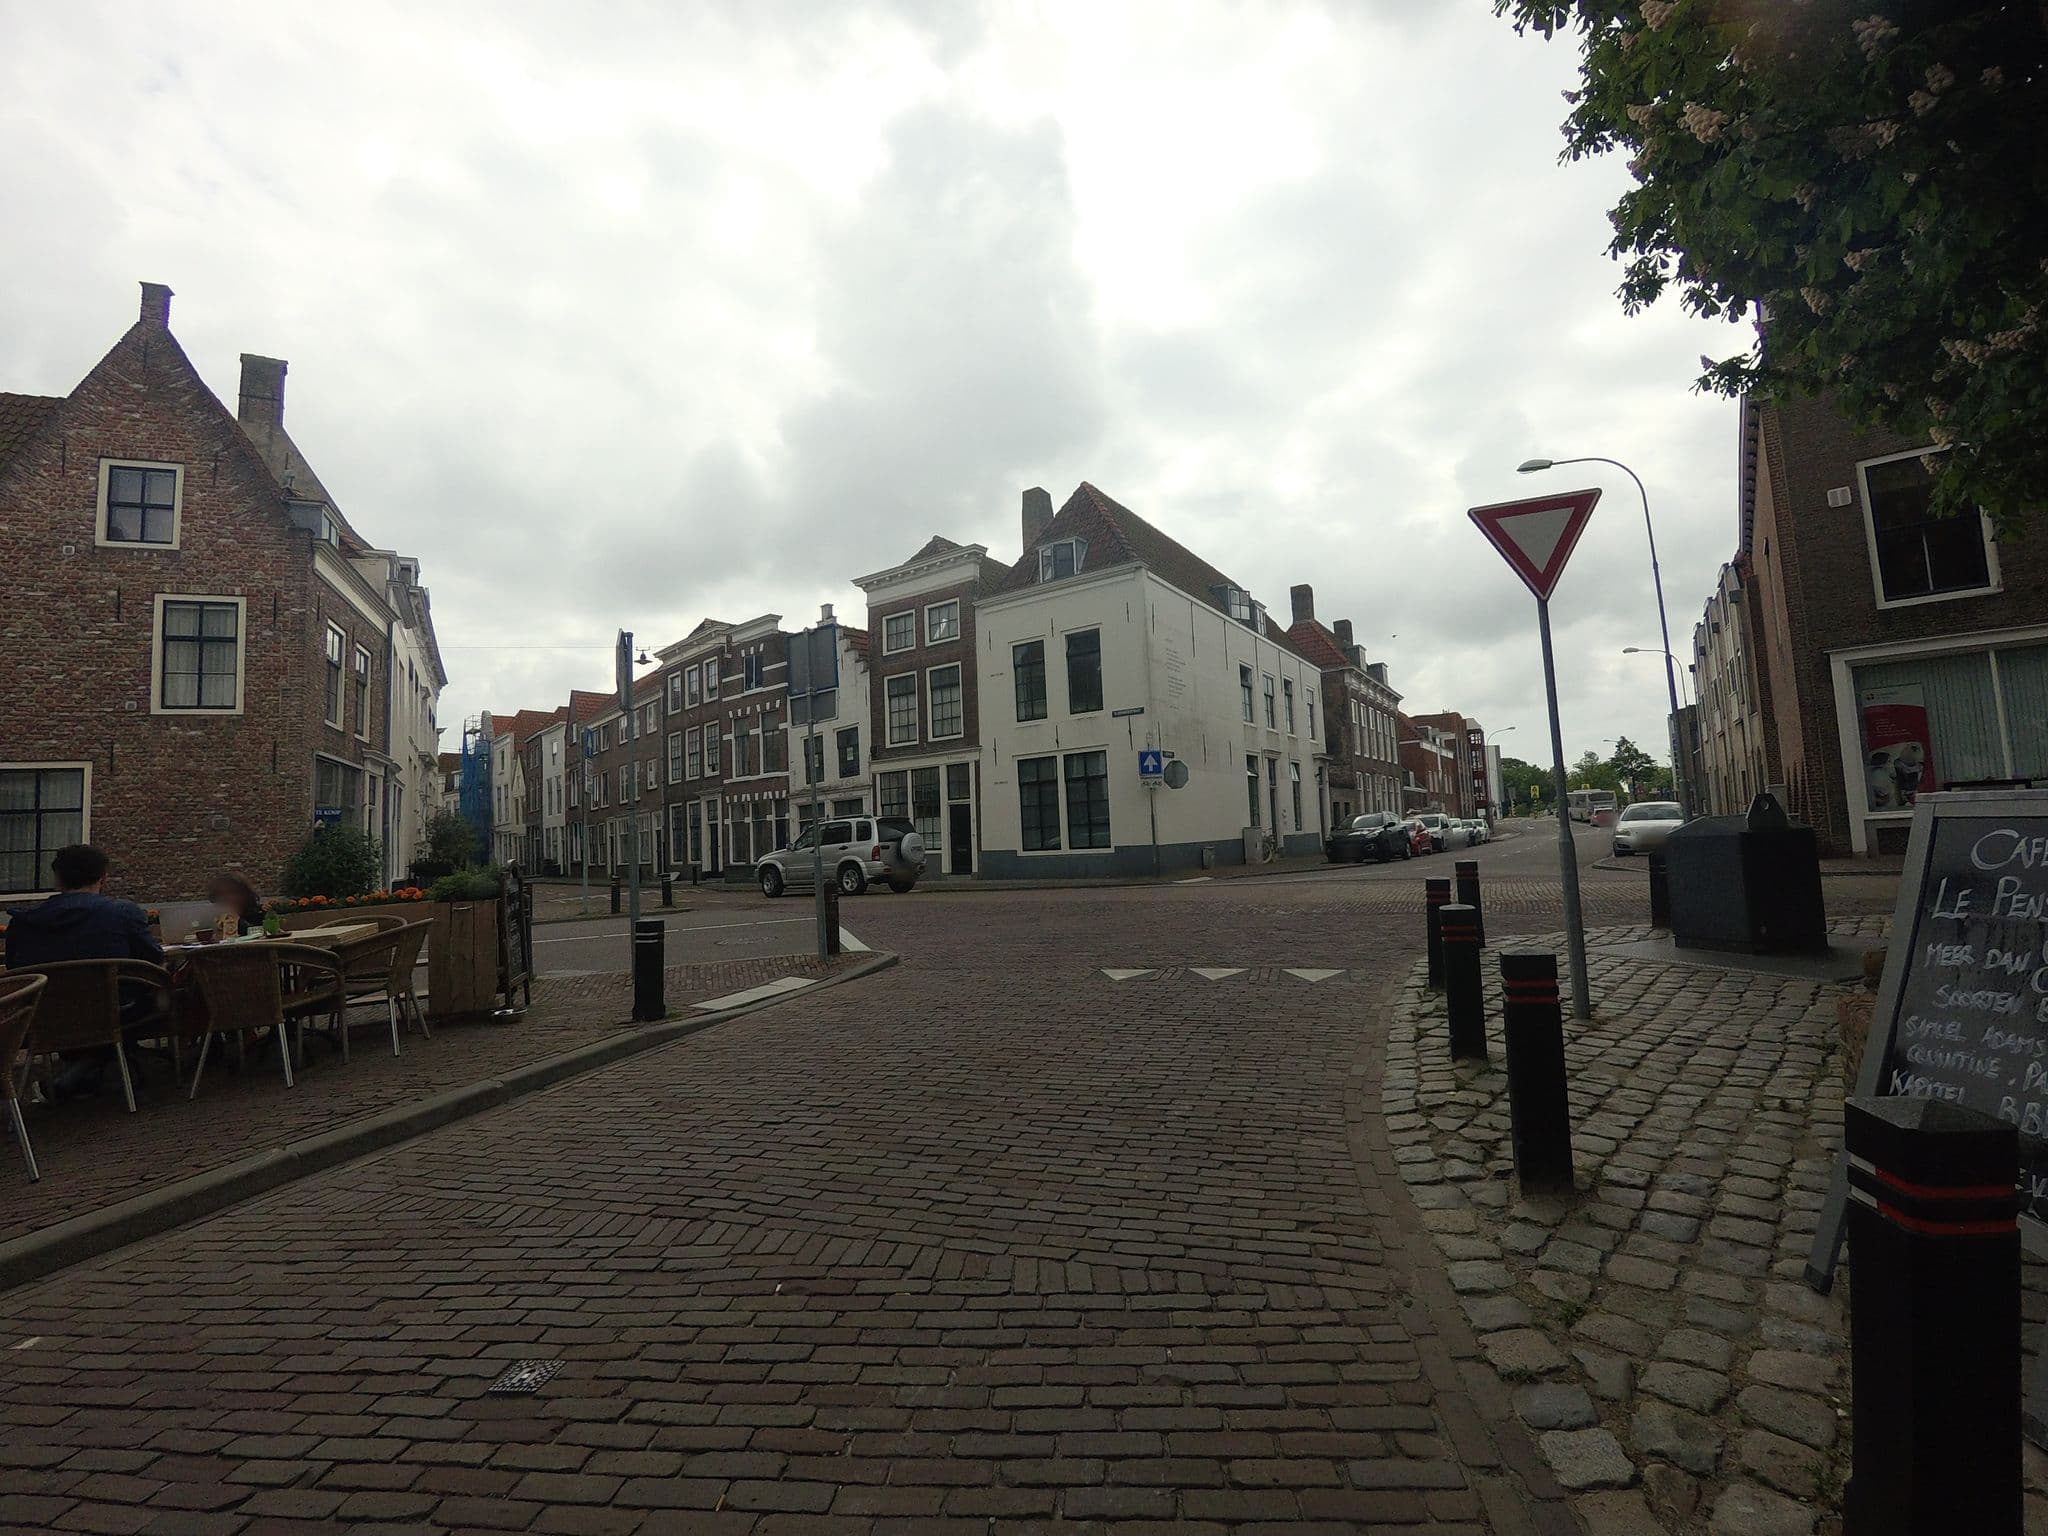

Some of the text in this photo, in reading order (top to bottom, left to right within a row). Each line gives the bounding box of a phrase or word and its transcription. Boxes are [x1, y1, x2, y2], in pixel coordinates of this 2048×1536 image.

[1931, 876, 1974, 920] LE
[1924, 943, 1976, 968] MEER
[1984, 948, 2033, 975] DAN
